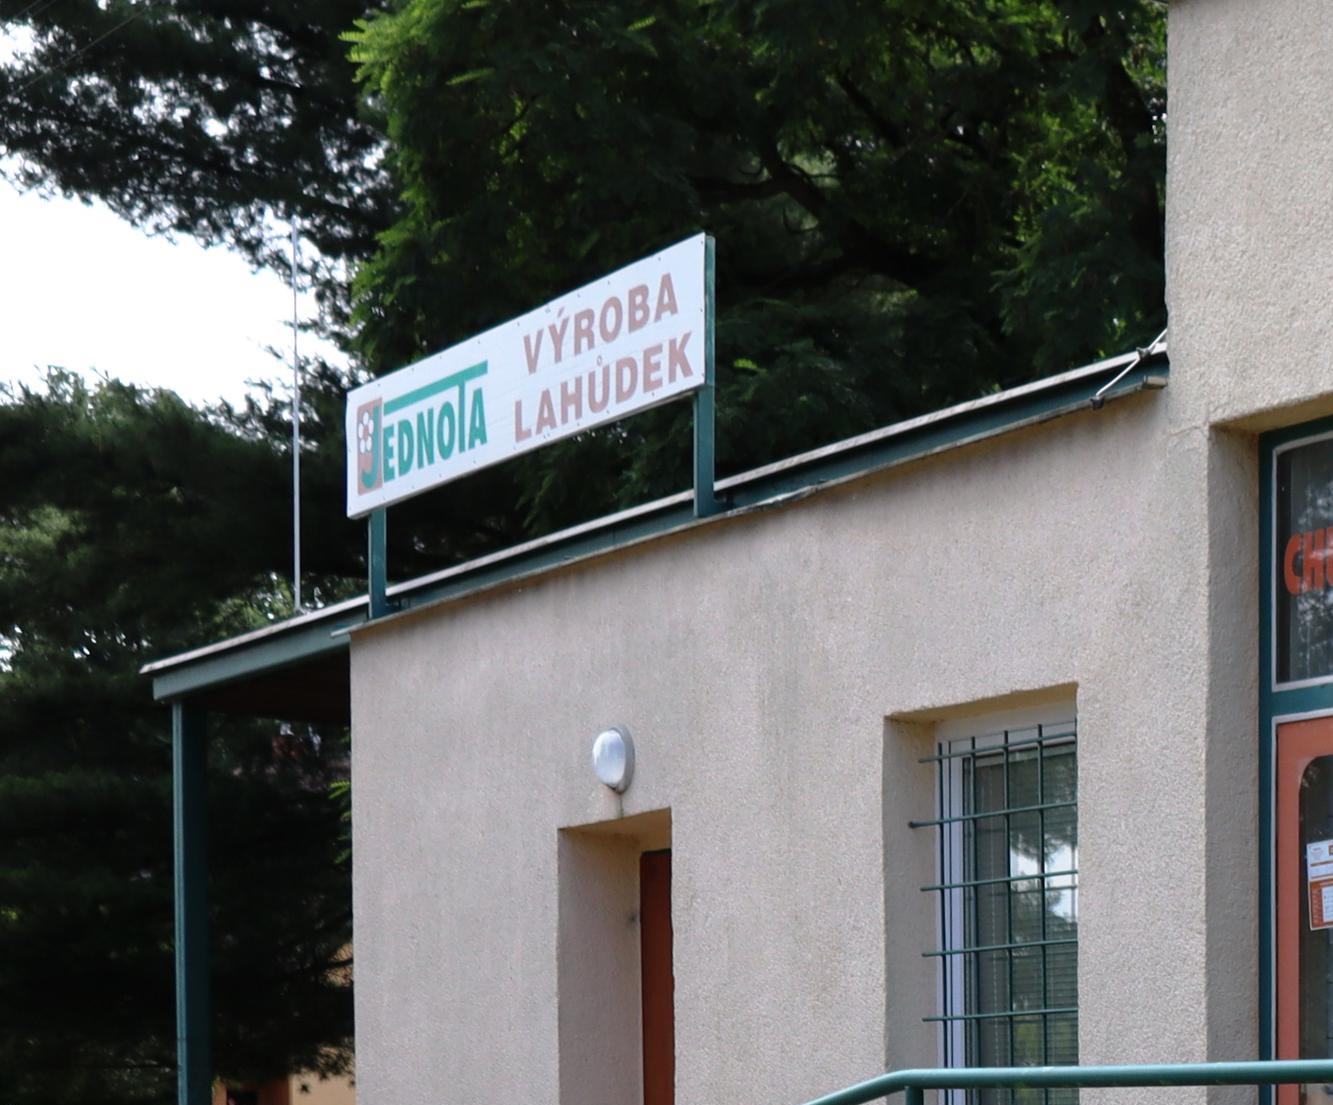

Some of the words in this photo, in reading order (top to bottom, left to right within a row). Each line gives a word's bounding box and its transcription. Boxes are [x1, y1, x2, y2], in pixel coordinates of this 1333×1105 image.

[523, 272, 679, 375] VÝROBA
[361, 360, 489, 489] JEDNOTA
[514, 331, 694, 443] LAHŮDEK
